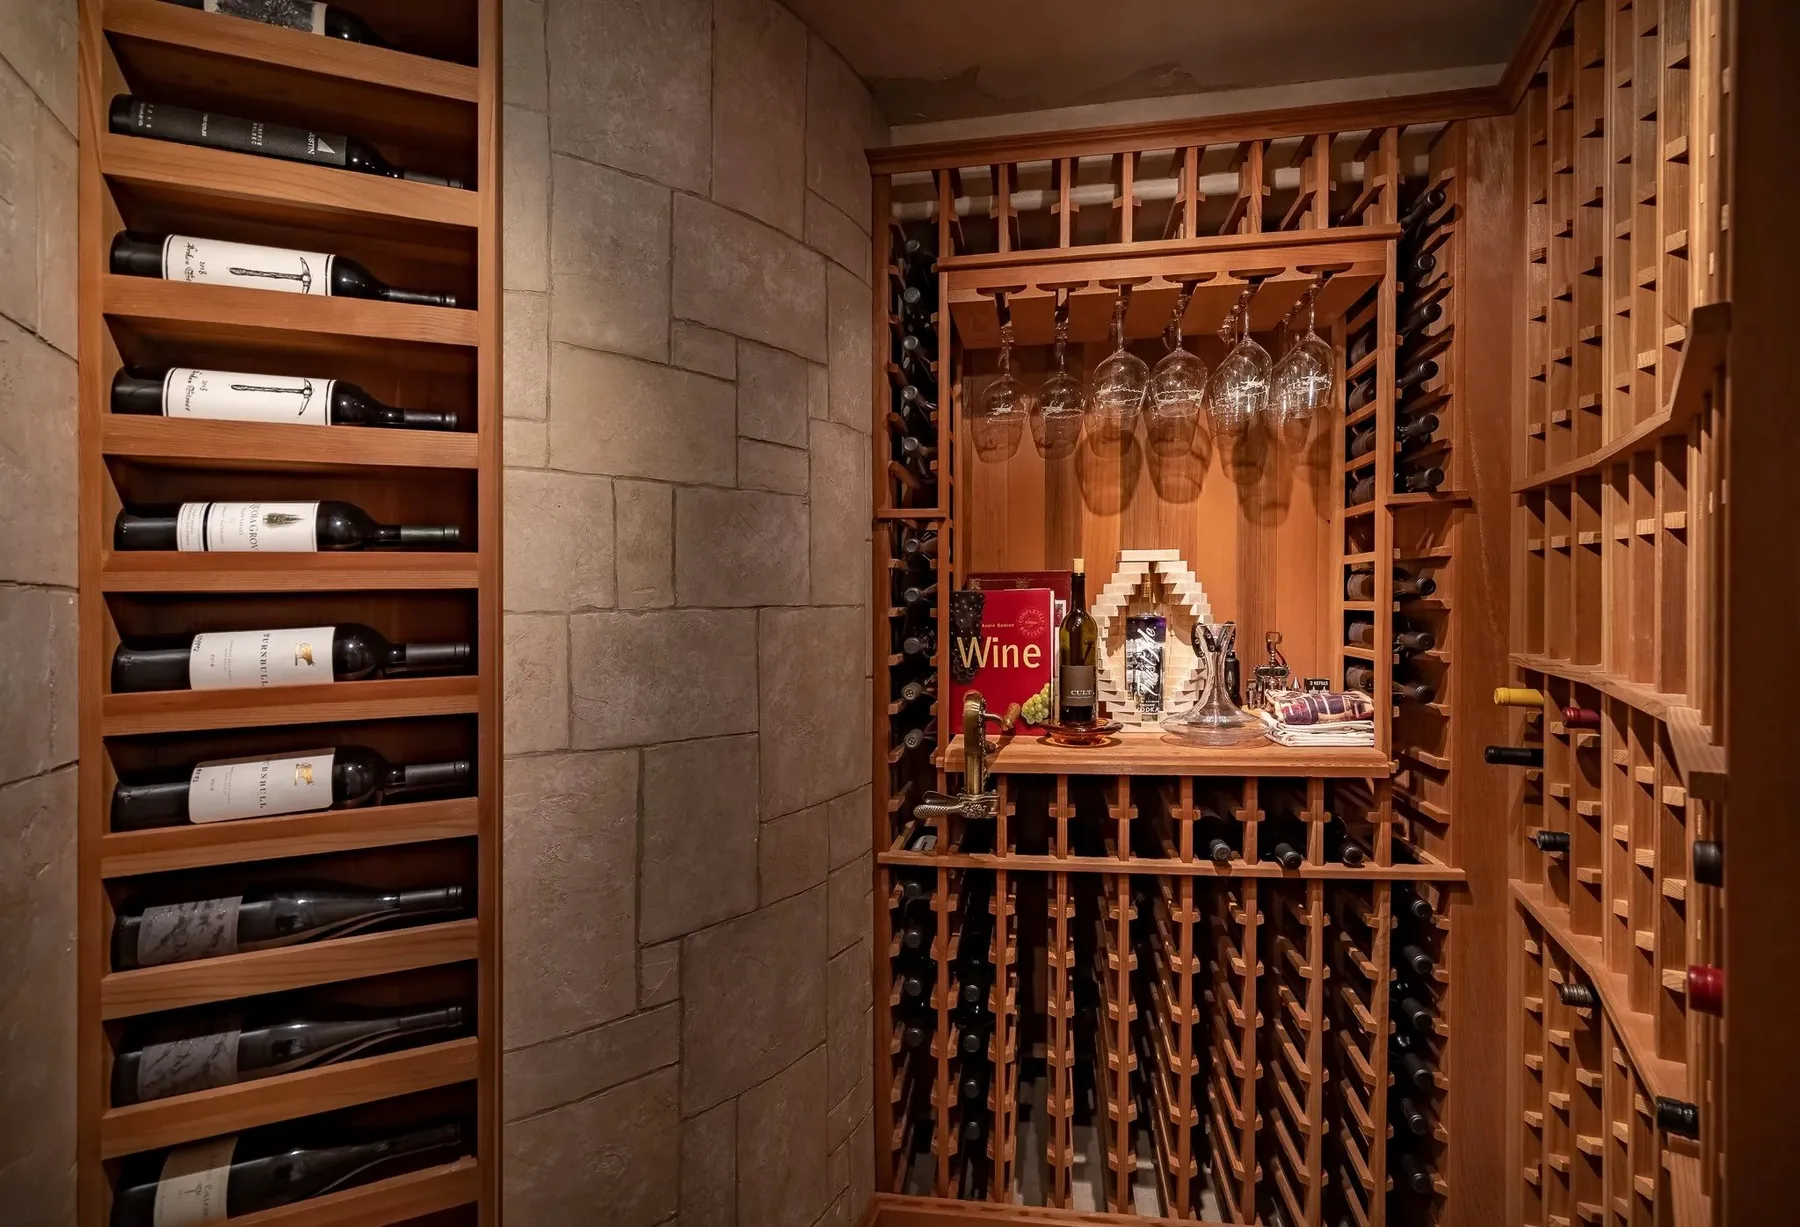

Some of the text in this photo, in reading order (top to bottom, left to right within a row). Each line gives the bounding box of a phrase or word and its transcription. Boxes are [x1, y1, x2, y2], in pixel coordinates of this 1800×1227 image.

[249, 524, 259, 550] GROV
[260, 633, 271, 686] TURNBULL
[957, 636, 1041, 668] Wine
